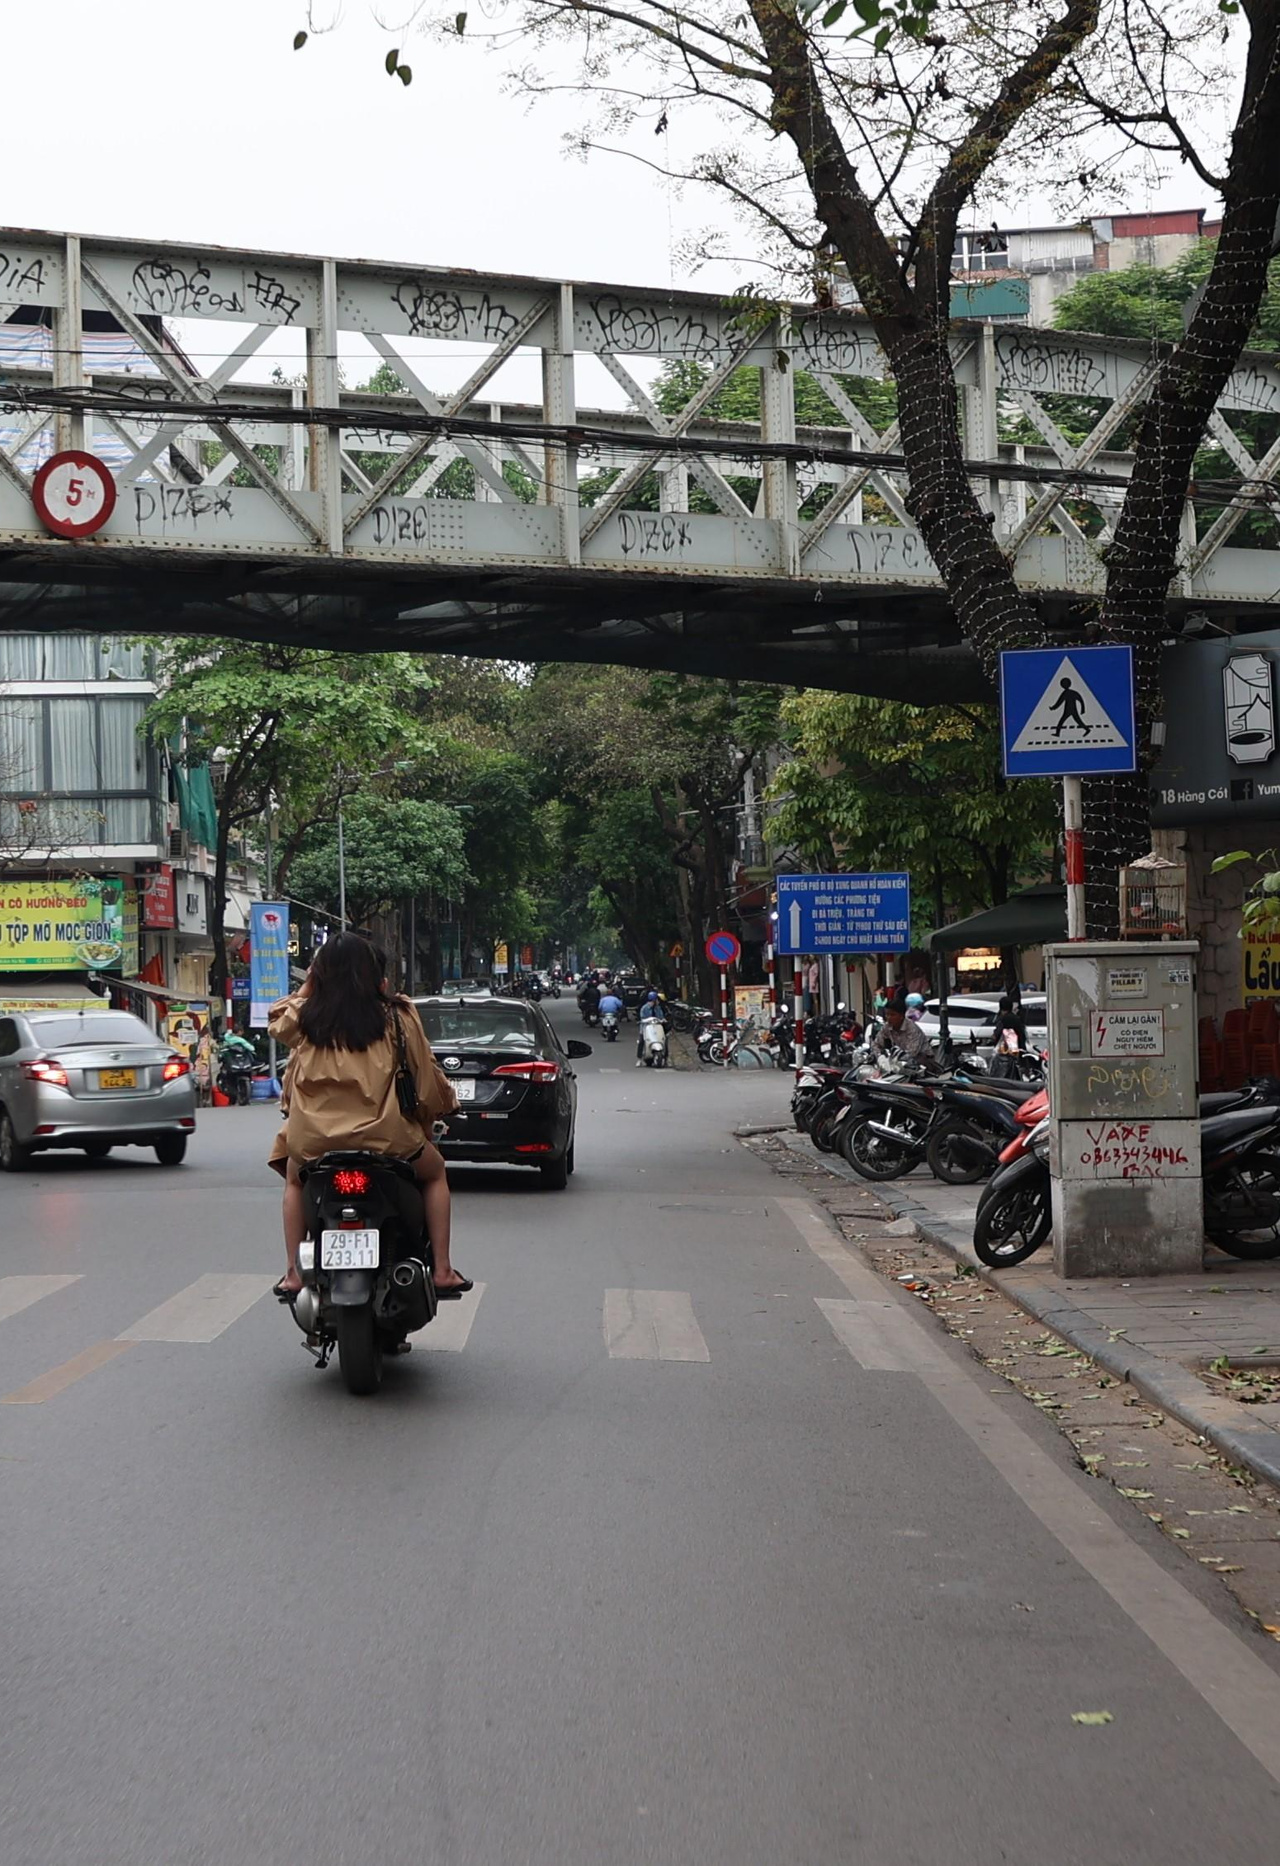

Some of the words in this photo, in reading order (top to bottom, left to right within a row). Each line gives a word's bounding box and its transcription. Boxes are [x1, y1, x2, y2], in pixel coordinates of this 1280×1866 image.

[66, 478, 84, 507] 5
[1161, 789, 1176, 804] 18
[1177, 790, 1206, 804] Hàng
[1207, 787, 1229, 800] Cót
[780, 879, 791, 891] CÁC
[809, 878, 819, 891] PHỐ
[833, 893, 845, 905] CÁC
[1109, 1014, 1126, 1024] CẤM
[1127, 1015, 1140, 1026] LẠI
[1133, 1042, 1157, 1050] NGƯỜI
[331, 1233, 370, 1249] 29-F1
[324, 1250, 373, 1267] 233.11
